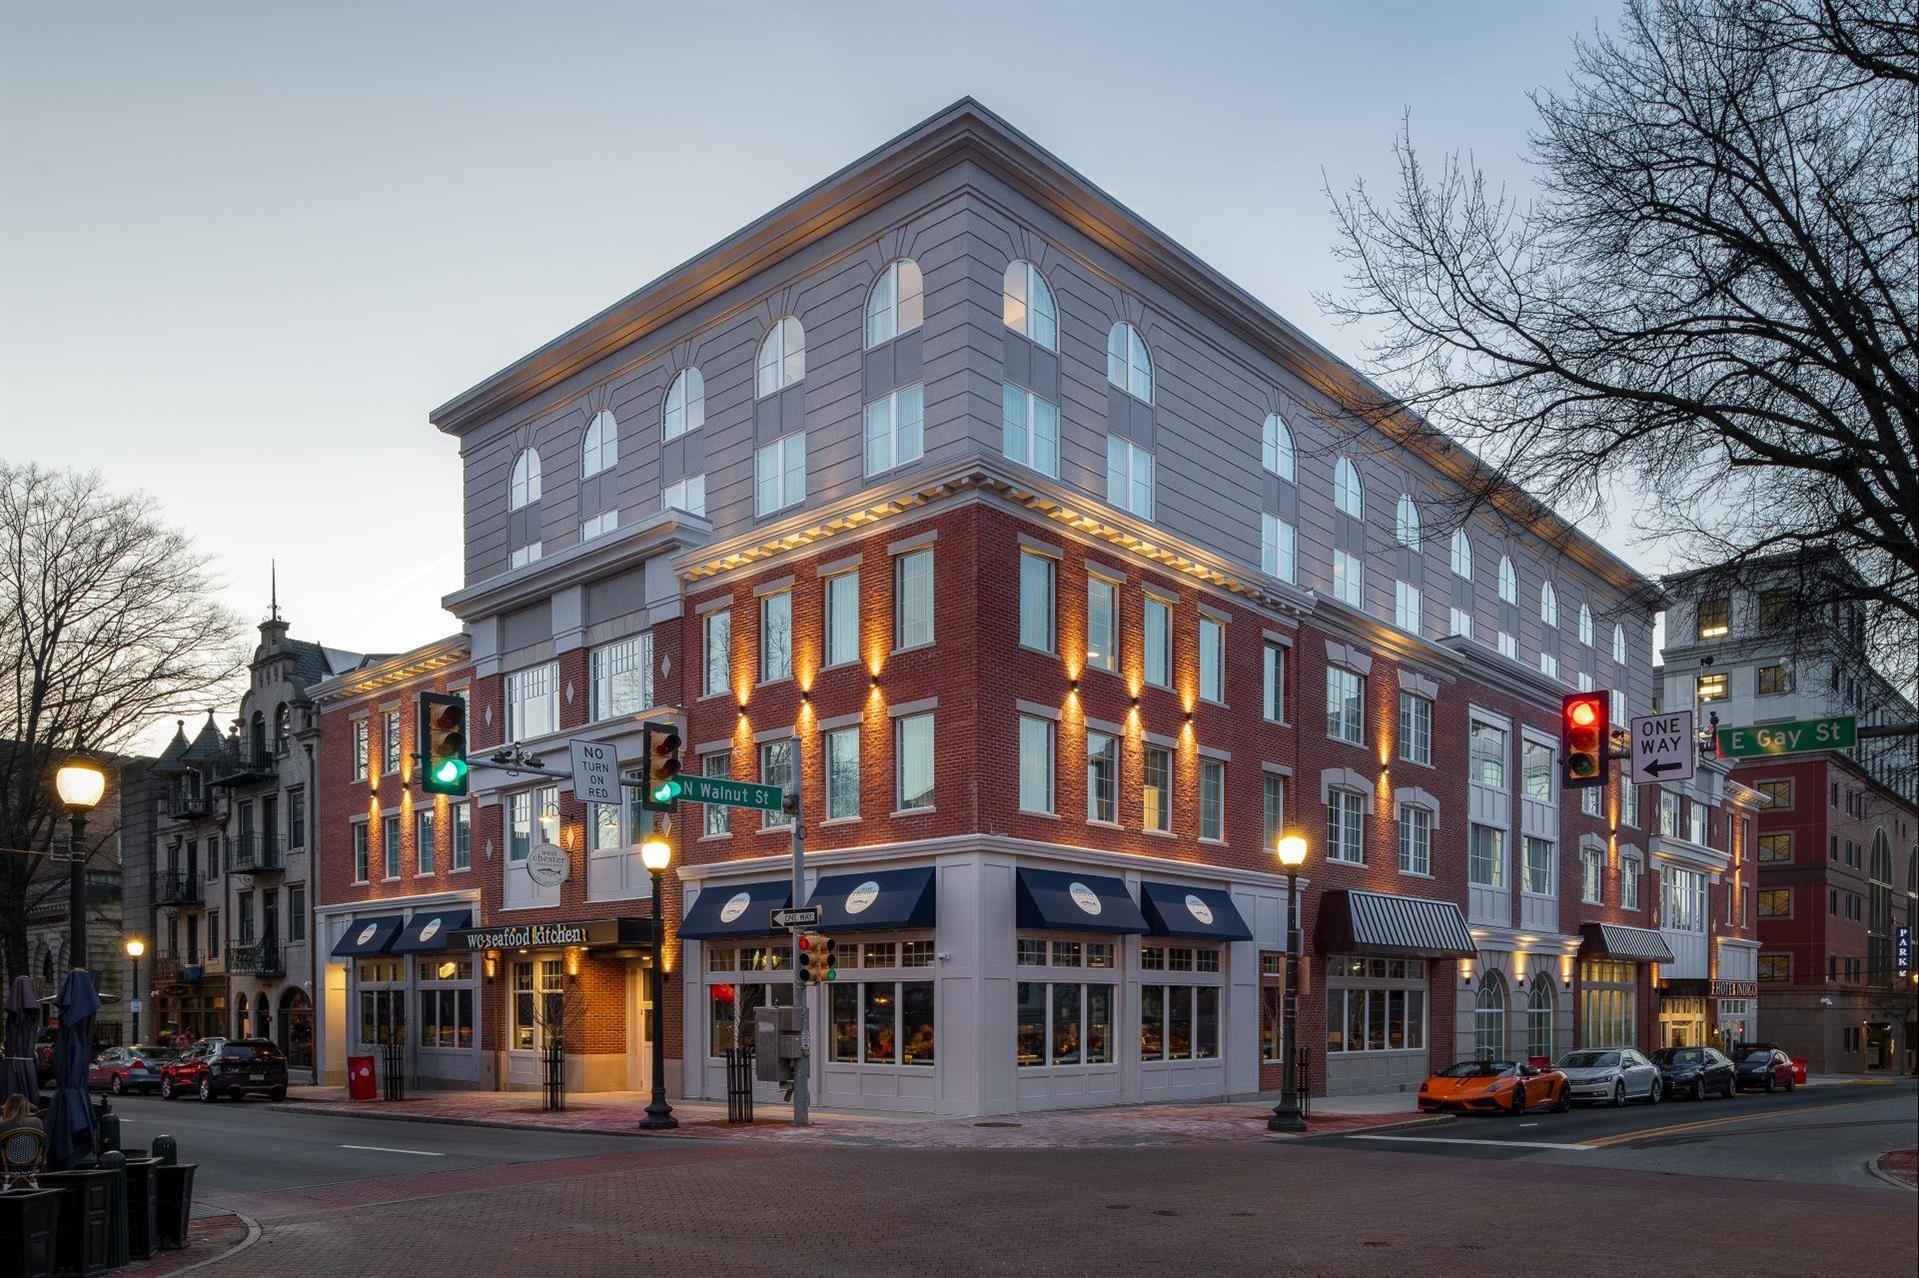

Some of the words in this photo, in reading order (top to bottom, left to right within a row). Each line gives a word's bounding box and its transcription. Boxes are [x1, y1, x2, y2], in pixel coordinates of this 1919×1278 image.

[1642, 718, 1680, 737] ONE
[1731, 732, 1744, 750] E
[1757, 729, 1801, 749] Gay
[1816, 723, 1840, 742] St
[584, 746, 604, 760] NO
[1641, 737, 1681, 754] WAY
[582, 761, 609, 773] TURN
[590, 775, 604, 785] ON
[588, 788, 608, 798] RED
[683, 781, 693, 796] N
[700, 783, 748, 803] Walnut
[755, 790, 769, 805] St
[532, 853, 566, 864] chester
[784, 913, 798, 922] ONE
[800, 912, 813, 921] WAY
[486, 927, 529, 948] seafood
[535, 924, 581, 945] kitchen
[1898, 929, 1908, 966] PARK
